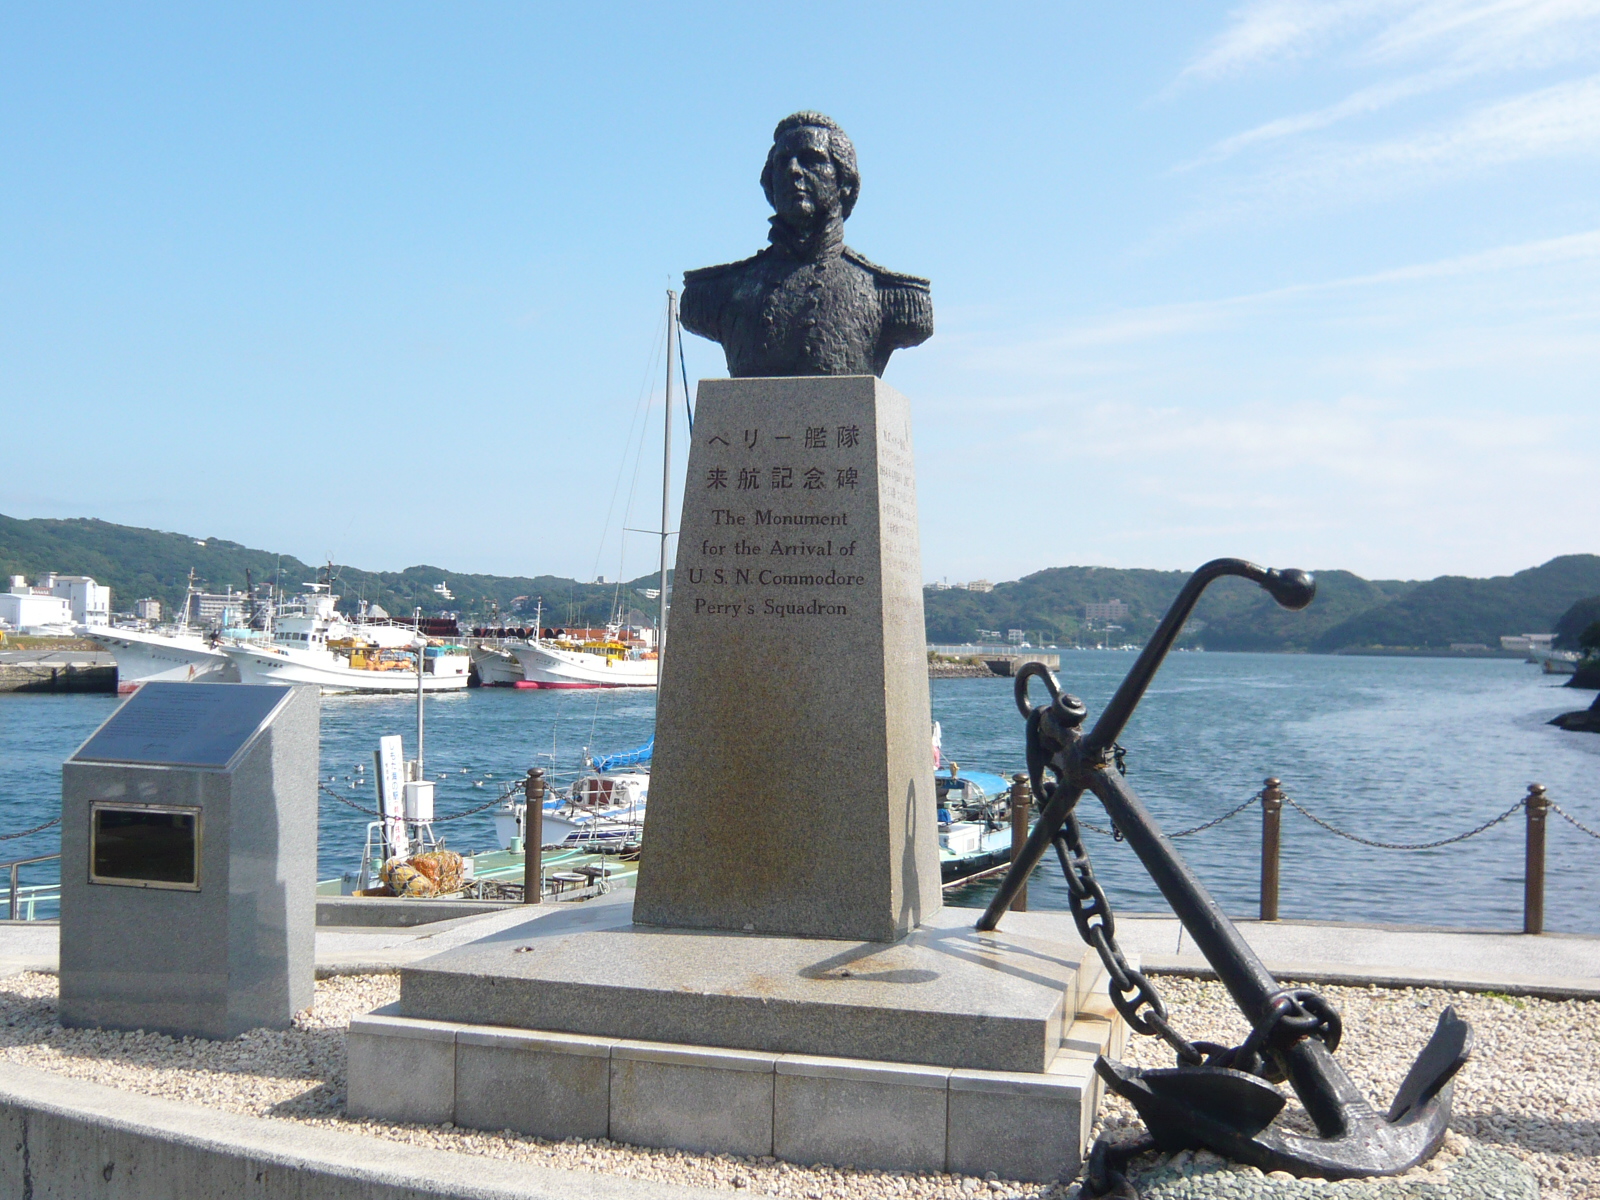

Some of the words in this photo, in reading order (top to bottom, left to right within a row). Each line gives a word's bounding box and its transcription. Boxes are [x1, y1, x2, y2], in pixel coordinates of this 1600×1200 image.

[708, 425, 860, 449] ペリー艦隊
[706, 467, 859, 490] 来航記念碑
[711, 509, 746, 526] The
[755, 509, 848, 526] Monument
[702, 540, 726, 556] for
[735, 540, 761, 556] the
[770, 540, 832, 556] Arrival
[839, 541, 856, 556] of
[758, 569, 865, 586] Commodore
[695, 598, 755, 618] Perry's
[763, 599, 848, 618] Squadron
